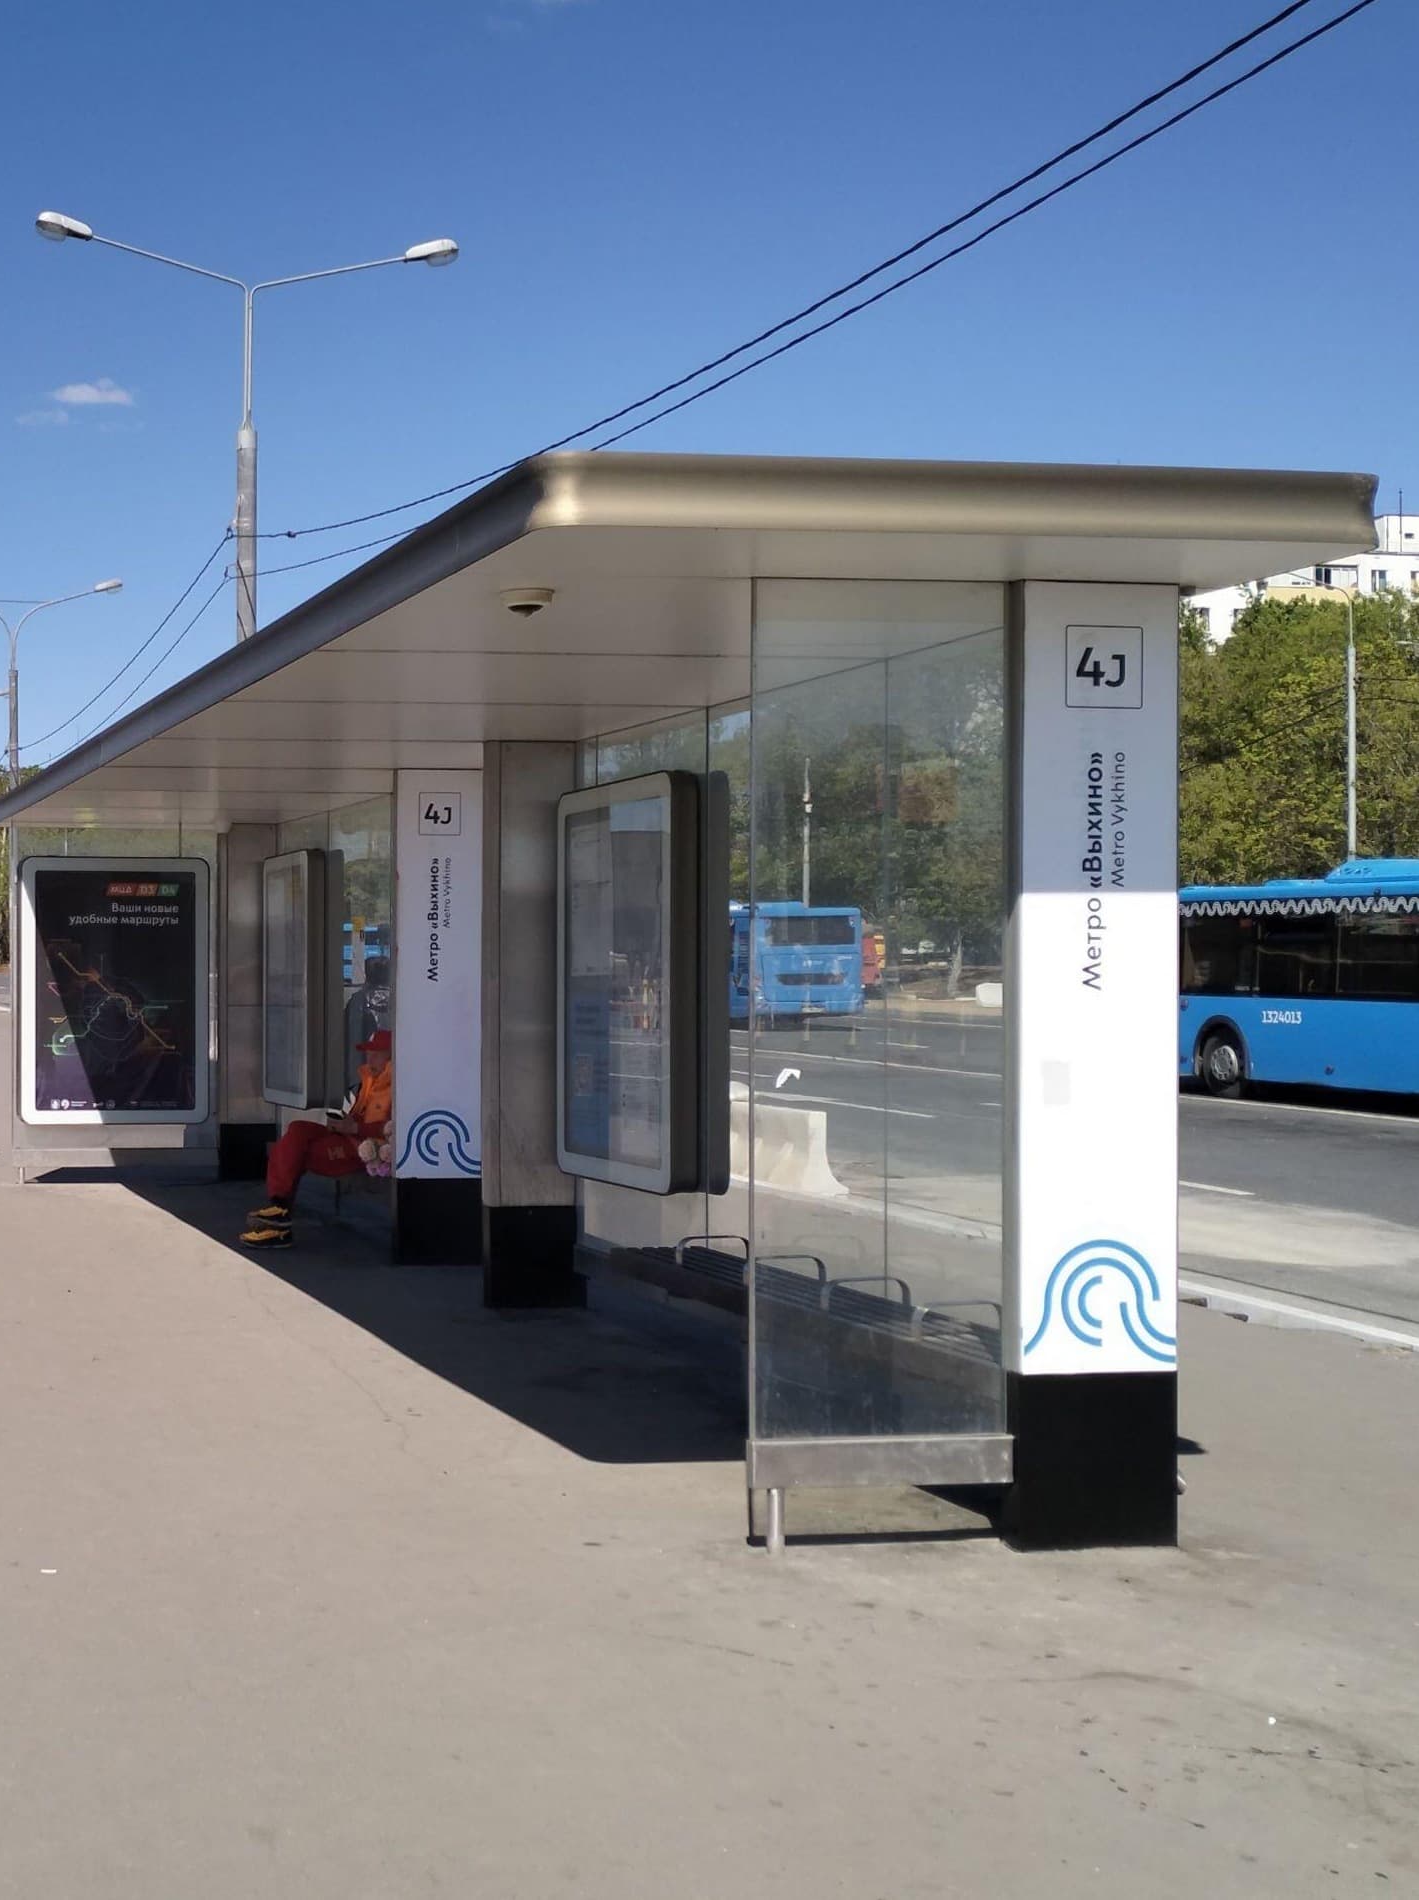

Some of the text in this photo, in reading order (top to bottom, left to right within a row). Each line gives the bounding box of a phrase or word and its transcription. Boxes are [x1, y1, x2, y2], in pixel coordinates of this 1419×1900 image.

[1076, 647, 1127, 687] 4J
[424, 803, 453, 825] 4J
[1110, 752, 1128, 887] Metro Vykhino
[443, 857, 453, 928] Metro Vykhino
[1082, 752, 1107, 990] Метро «Выхино»
[68, 914, 180, 927] удобные маршруты
[111, 902, 180, 913] Ваши новые
[427, 858, 441, 982] Метро «Выхино»
